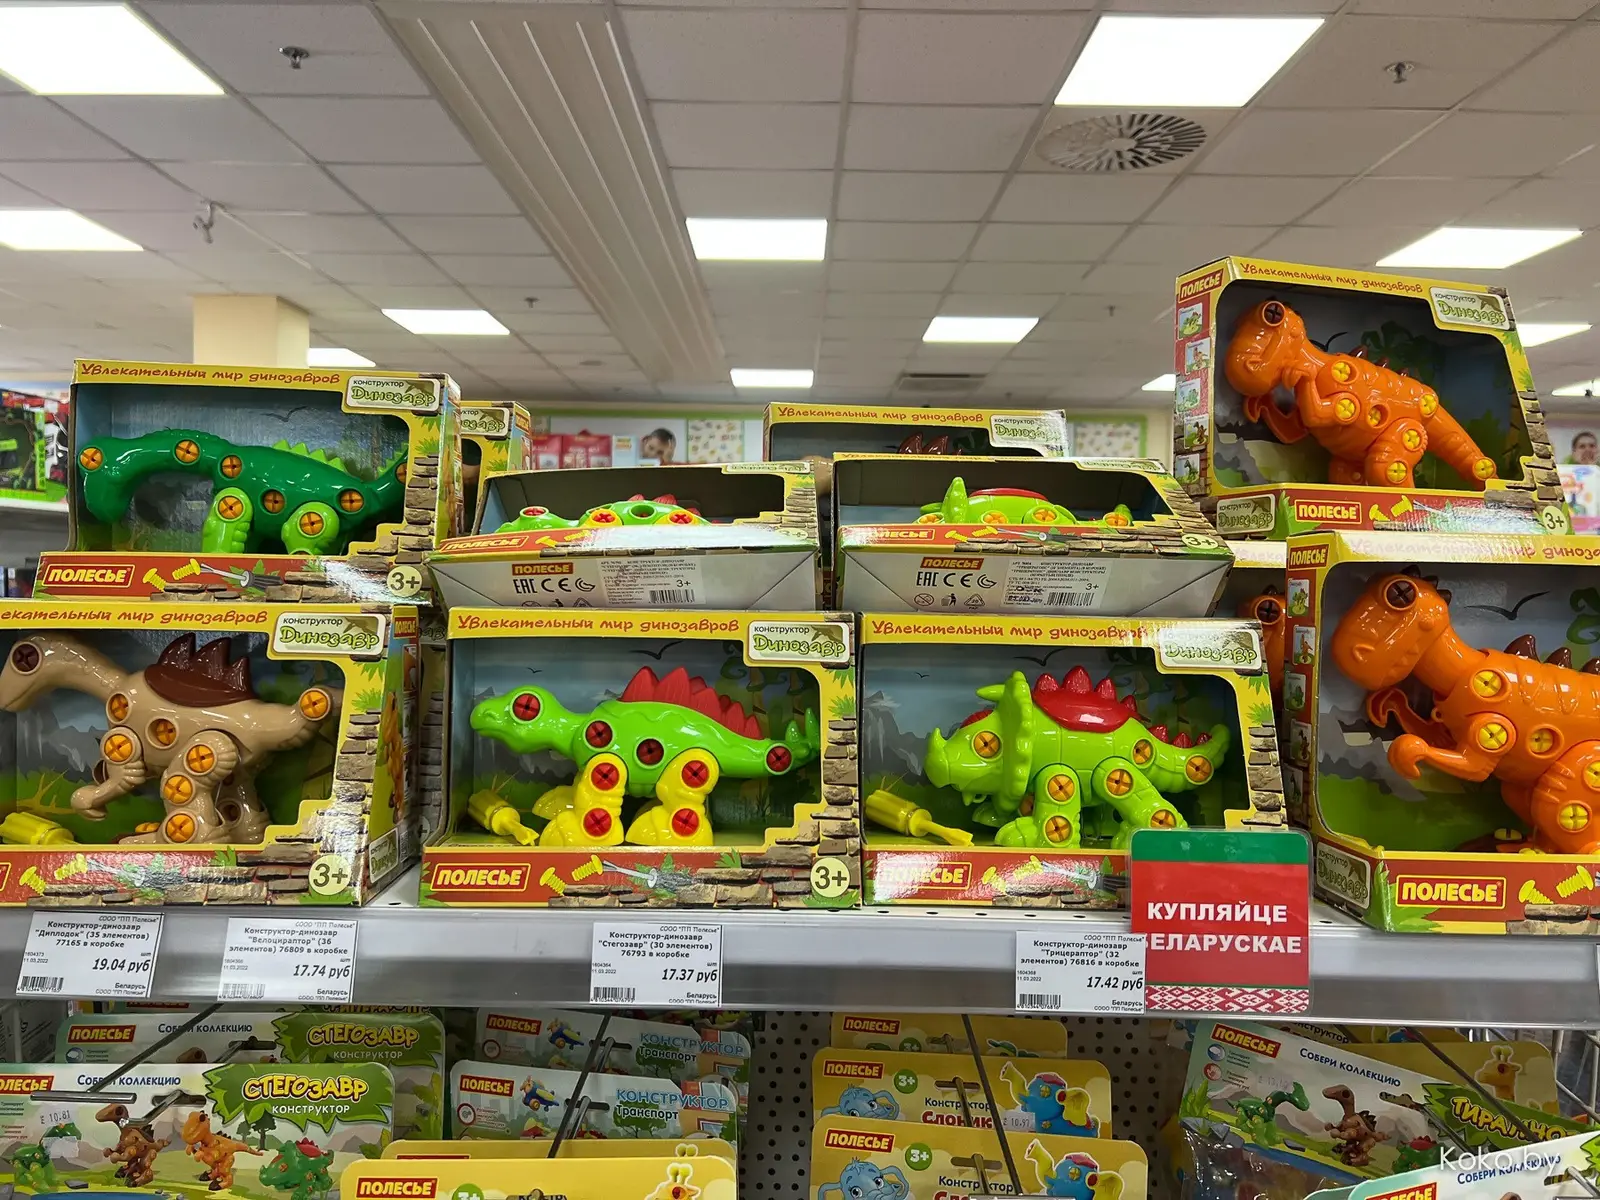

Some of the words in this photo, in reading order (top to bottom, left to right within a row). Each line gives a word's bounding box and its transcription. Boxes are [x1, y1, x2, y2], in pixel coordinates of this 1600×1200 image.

[1240, 262, 1333, 283] Увлекательный
[1336, 276, 1358, 287] мир
[1361, 279, 1423, 293] динозавров
[1181, 273, 1221, 298] ПОЛЕСЬЕ
[1434, 293, 1476, 303] конструктор
[1437, 300, 1506, 325] Динозавр
[81, 363, 206, 379] Увлекательный
[212, 371, 243, 382] мир
[248, 372, 341, 384] динозавров
[353, 378, 404, 388] конструктор
[351, 386, 436, 406] Динозавр
[778, 406, 877, 419] Увлекательный
[882, 411, 906, 421] мир
[911, 412, 983, 423] динозавров
[1219, 502, 1251, 511] конструктор
[1299, 504, 1357, 520] ПОЛЕСЬЕ
[1218, 511, 1273, 529] Динозавр
[1544, 512, 1564, 530] 3+
[447, 538, 521, 550] ПОЛЕСЬЕ
[1185, 536, 1216, 546] 3+
[1290, 548, 1326, 566] ПОЛЕСЬЕ
[1544, 547, 1600, 560] диноза
[514, 563, 570, 575] ПОЛЕСЬЕ
[922, 558, 979, 569] ПОЛЕСЬЕ
[46, 567, 128, 585] ПОЛЕСЬЕ
[389, 571, 421, 592] 3+
[676, 579, 691, 588] 3+
[1085, 582, 1100, 591] 3+
[1, 610, 112, 622] екательный
[117, 611, 154, 624] мир
[160, 610, 268, 625] динозавров
[283, 617, 343, 626] конструктор
[457, 615, 593, 631] Увлекательный
[600, 618, 633, 632] мир
[640, 618, 740, 634] динозавров
[279, 625, 380, 649] Динозавр
[754, 625, 810, 635] конструктор
[872, 620, 1004, 636] Увлекательный
[1010, 625, 1043, 640] мир
[752, 634, 846, 657] Динозавр
[1164, 642, 1257, 664] Динозавр
[312, 863, 349, 887] 3+
[436, 870, 523, 886] ПОЛЕСЬЕ
[814, 865, 848, 888] 3+
[1402, 882, 1498, 903] ПОЛЕСЬЕ
[1147, 901, 1288, 925] КУПЛЯЙЦЕ
[47, 921, 141, 932] Конструктор-динозавр
[244, 927, 338, 937] Конструктор-динозавр
[35, 929, 84, 938] "Диплодок"
[86, 931, 100, 939] (35
[102, 931, 150, 941] элементов)
[248, 936, 315, 946] "Велоцираптор"
[317, 937, 332, 946] (36
[609, 931, 703, 942] Конструктор-динозавр
[56, 939, 81, 947] 77165
[90, 940, 125, 948] коробке
[229, 946, 277, 954] элементов)
[279, 945, 304, 953] 76809
[314, 946, 348, 955] коробке
[598, 940, 648, 949] "Стегозавр"
[650, 941, 664, 950] (30
[666, 942, 713, 951] элементов)
[1033, 940, 1128, 951] Конструктор-динозавр
[656, 950, 690, 958] коробке
[1041, 949, 1103, 959] "Трицераптор"
[1105, 951, 1120, 959] (32
[92, 958, 125, 971] 19.04
[127, 959, 150, 973] руб
[1020, 958, 1068, 966] элементов)
[1070, 958, 1096, 966] 76816
[1105, 960, 1140, 968] коробке
[293, 964, 326, 977] 17.74
[328, 965, 350, 979] руб
[662, 968, 694, 981] 17.37
[696, 969, 718, 983] руб
[114, 982, 146, 991] Беларусь
[1086, 976, 1119, 989] 17.42
[1121, 977, 1144, 991] руб
[317, 988, 348, 996] Беларусь
[686, 992, 717, 1000] Беларусь
[1111, 999, 1143, 1008] Беларусь
[488, 1017, 538, 1033] ПОЛЕСЬЕ
[845, 1018, 897, 1033] ПОЛЕСЬЕ
[71, 1028, 132, 1041] ПОЛЕСЬЕ
[307, 1022, 420, 1049] СТЕГОЗАВР
[1215, 1027, 1276, 1055] ПОЛЕСЬЕ
[640, 1032, 744, 1056] КОНСТРУКТОР
[333, 1051, 403, 1060] КОНСТРУКТОР
[640, 1045, 697, 1062] Транспорт
[826, 1063, 880, 1077] ПОЛЕСЬЕ
[0, 1078, 49, 1091] ОЛЕСЬЕ
[243, 1073, 370, 1103] СТЕГОЗАВР
[462, 1078, 511, 1094] ПОЛЕСЬЕ
[898, 1075, 916, 1087] 3+
[616, 1089, 728, 1109] КОНСТРУКТОР
[272, 1104, 350, 1116] КОНСТРУКТОР
[616, 1104, 679, 1121] Транспорт
[828, 1132, 890, 1150] ПОЛЕСЬЕ
[910, 1149, 929, 1163] 3+
[359, 1181, 432, 1196] ПОЛЕСЬЕ
